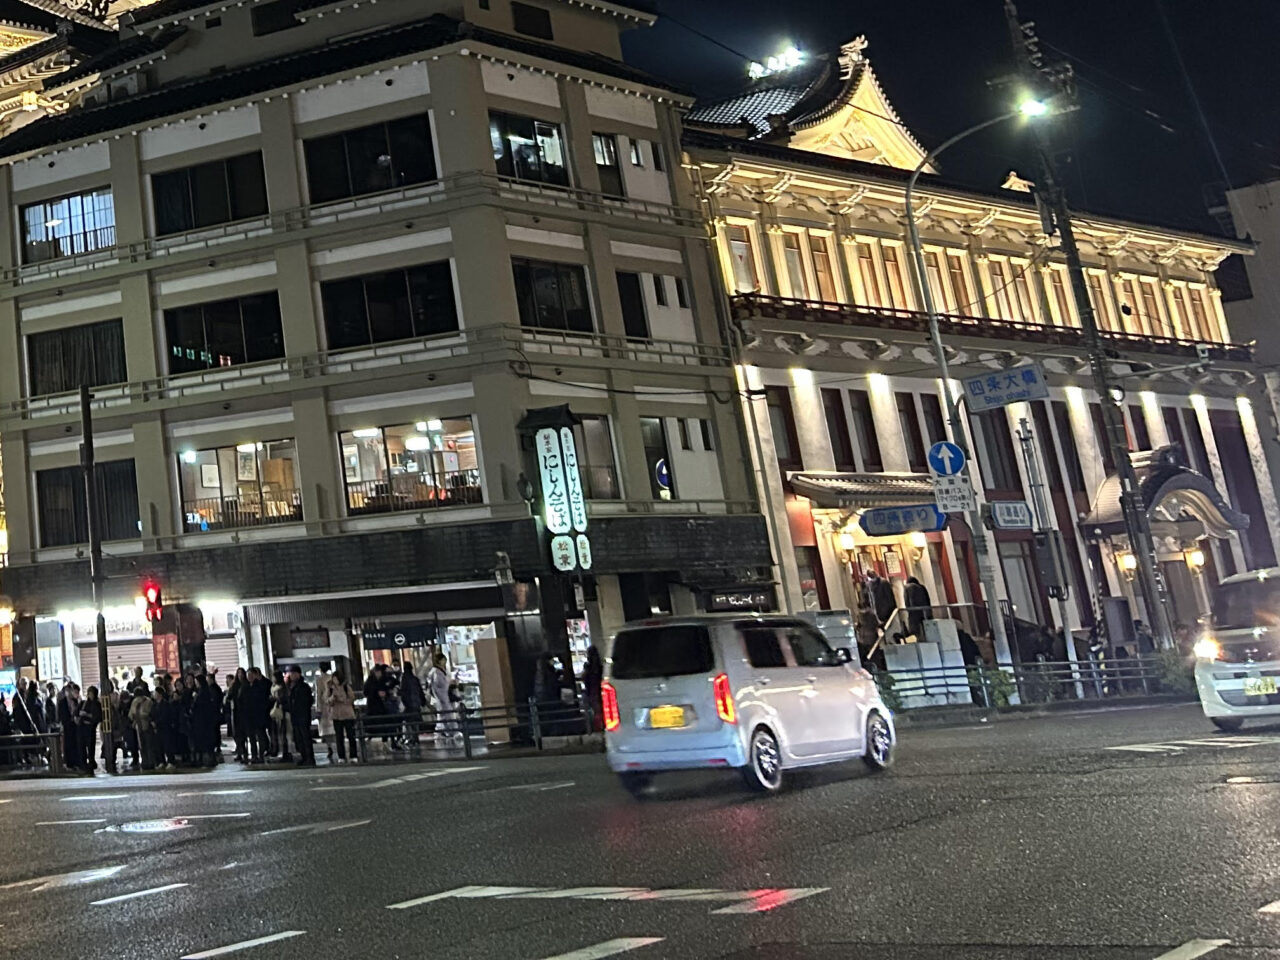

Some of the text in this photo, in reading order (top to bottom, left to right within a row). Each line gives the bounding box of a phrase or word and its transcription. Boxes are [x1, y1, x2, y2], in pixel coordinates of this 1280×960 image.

[543, 454, 567, 527] にしんそば
